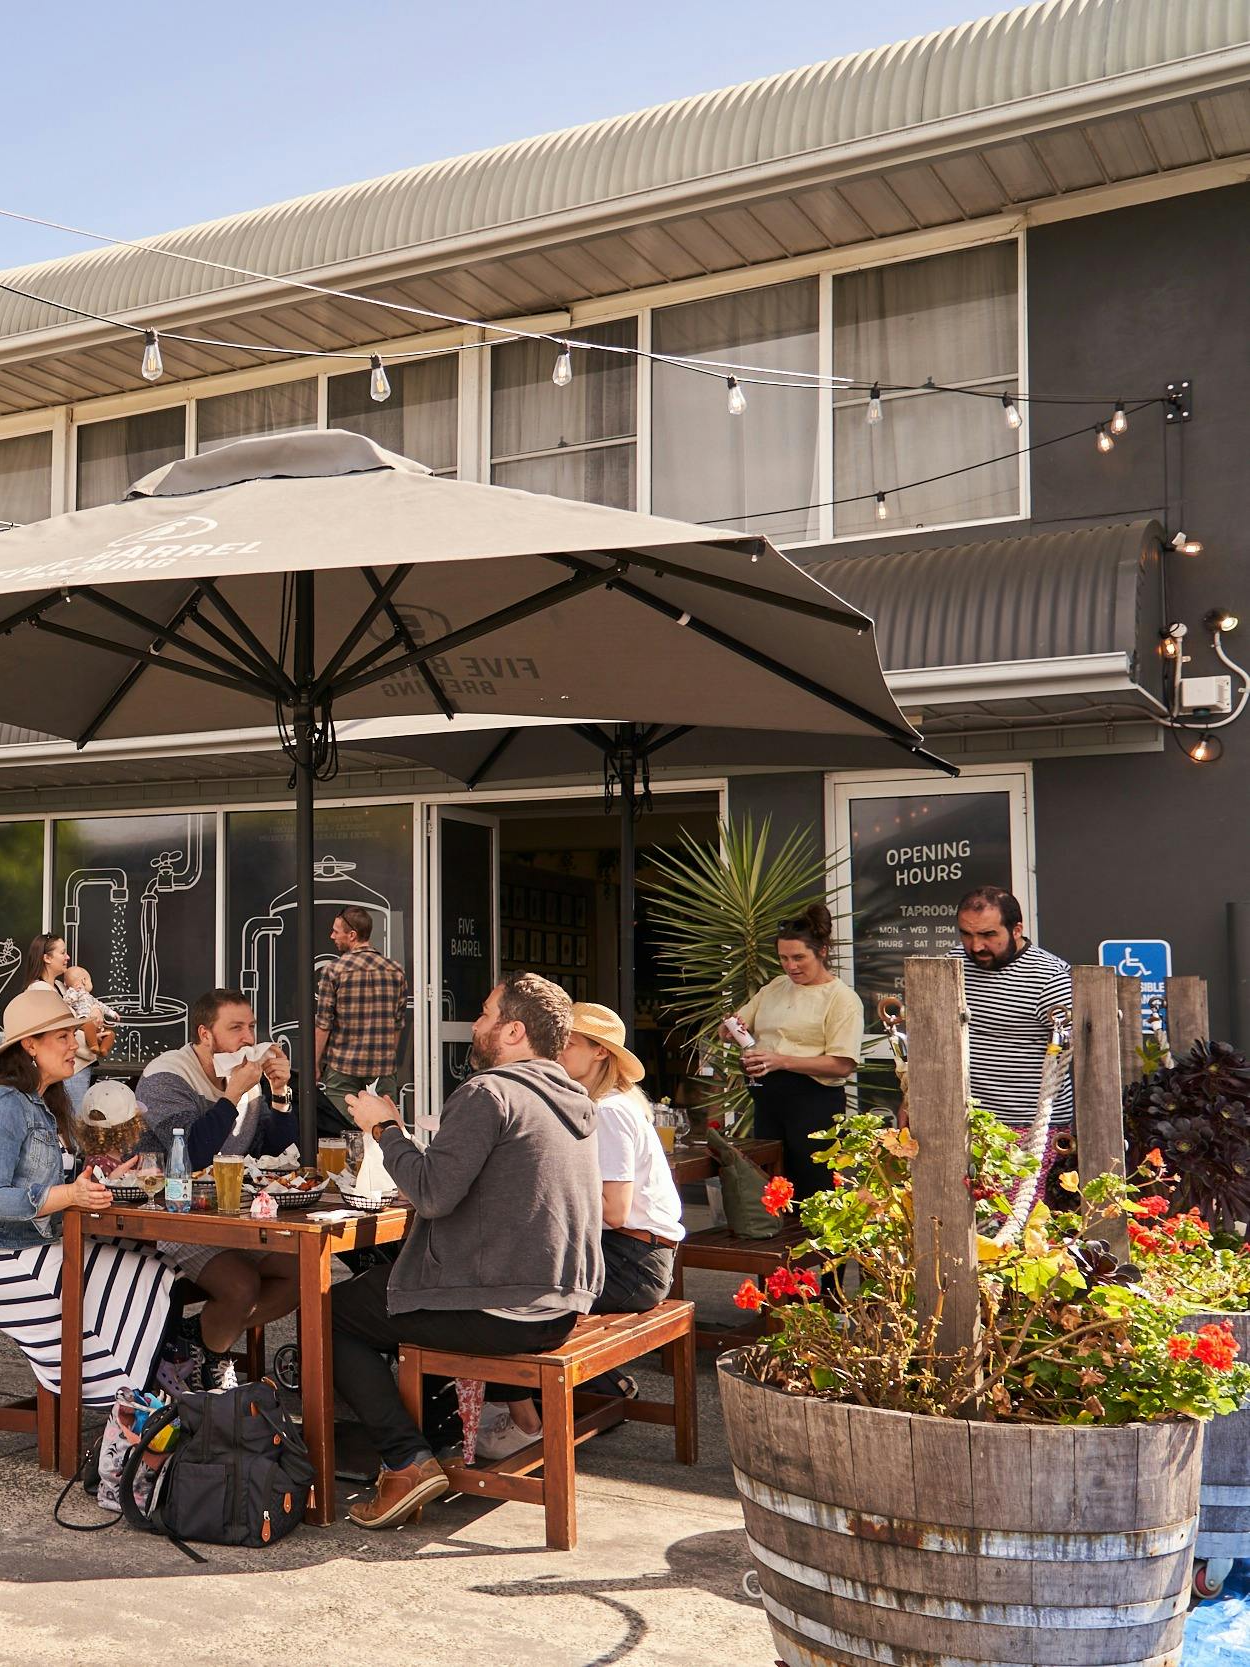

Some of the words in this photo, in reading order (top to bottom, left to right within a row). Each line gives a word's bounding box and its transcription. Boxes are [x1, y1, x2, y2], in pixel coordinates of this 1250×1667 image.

[886, 840, 971, 866] OPENING
[895, 862, 963, 887] HOURS
[458, 917, 475, 935] FIVE
[878, 926, 899, 934] MON
[909, 926, 928, 934] WED
[935, 925, 956, 934] 12PM
[451, 939, 482, 957] BARREL
[877, 940, 904, 948] THURS
[913, 940, 929, 948] SAT
